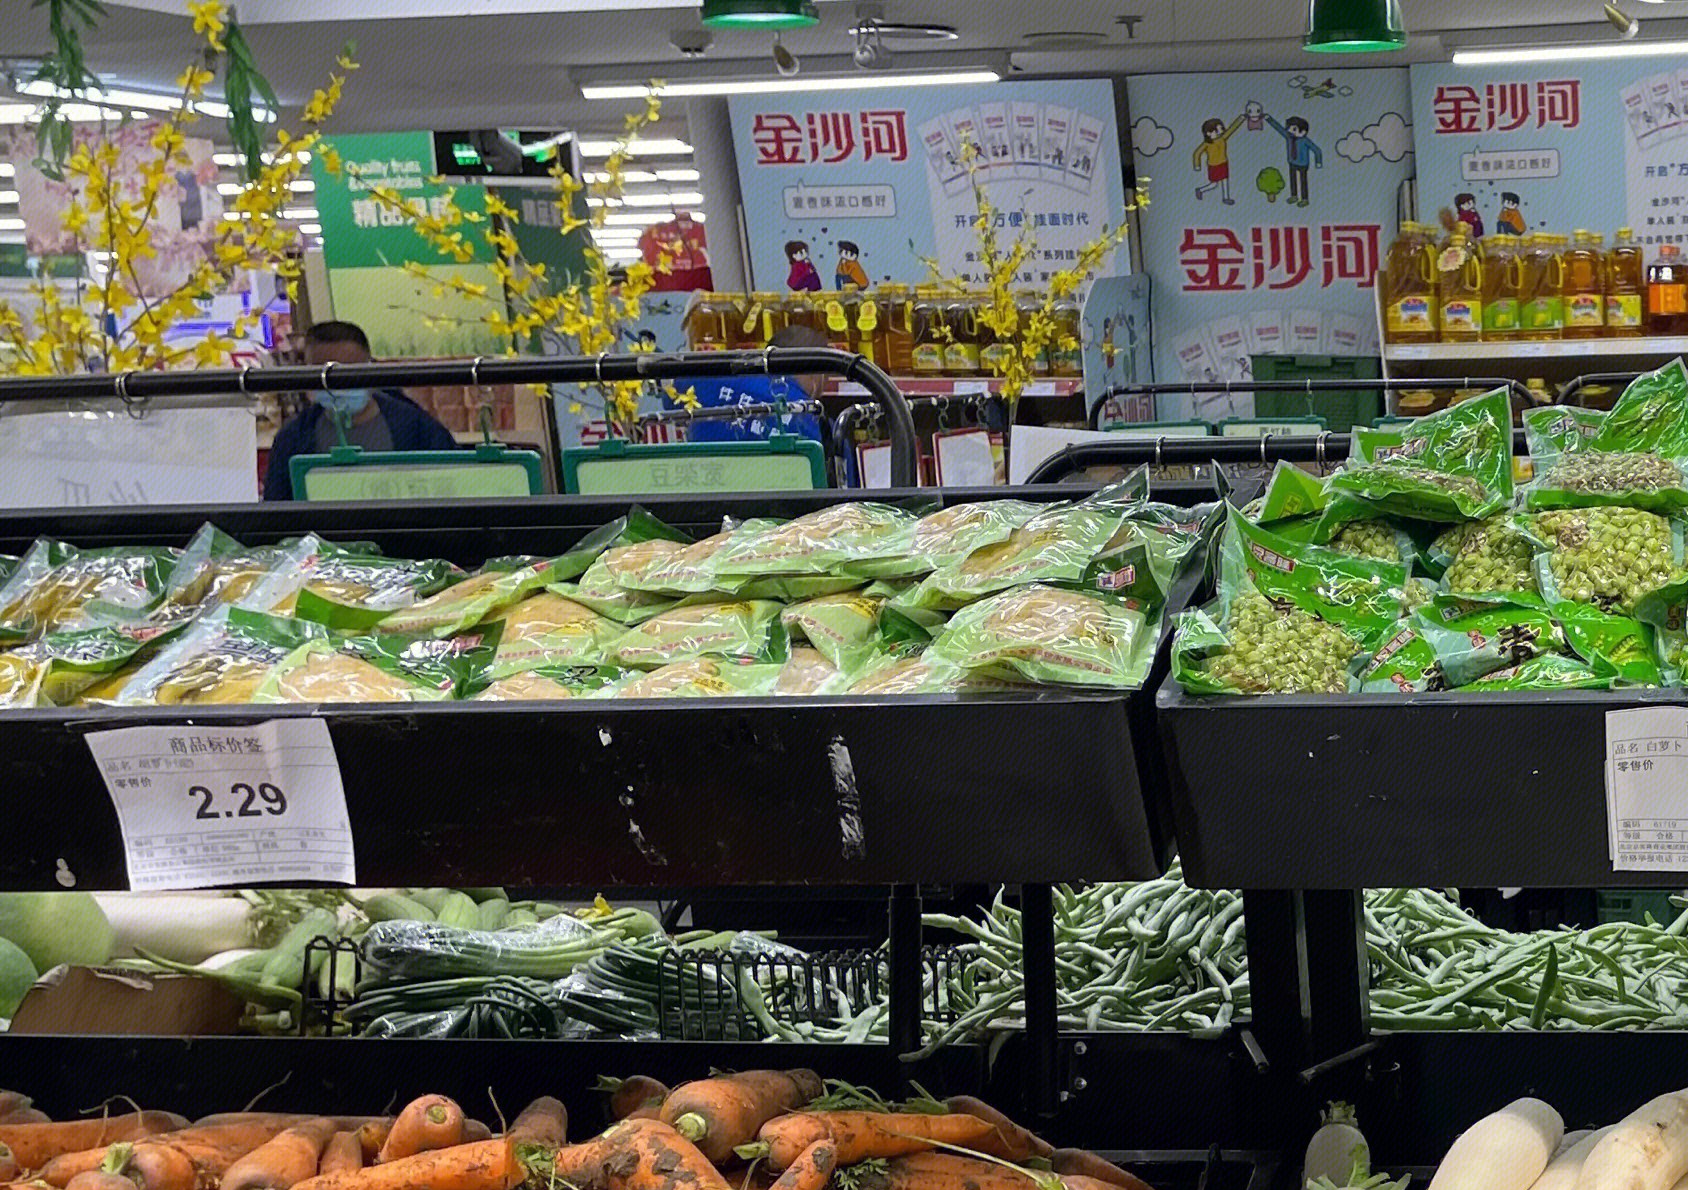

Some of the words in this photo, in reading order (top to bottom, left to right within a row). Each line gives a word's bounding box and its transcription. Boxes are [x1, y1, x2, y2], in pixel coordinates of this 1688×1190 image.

[1433, 79, 1581, 134] 金沙河
[752, 110, 908, 165] 金沙河
[1180, 223, 1380, 291] 金沙河
[168, 737, 264, 754] 商品标价签
[1615, 743, 1639, 755] 品名
[1646, 741, 1682, 753] 白萝卜
[1617, 759, 1654, 772] 零售价
[188, 782, 288, 819] 2.29
